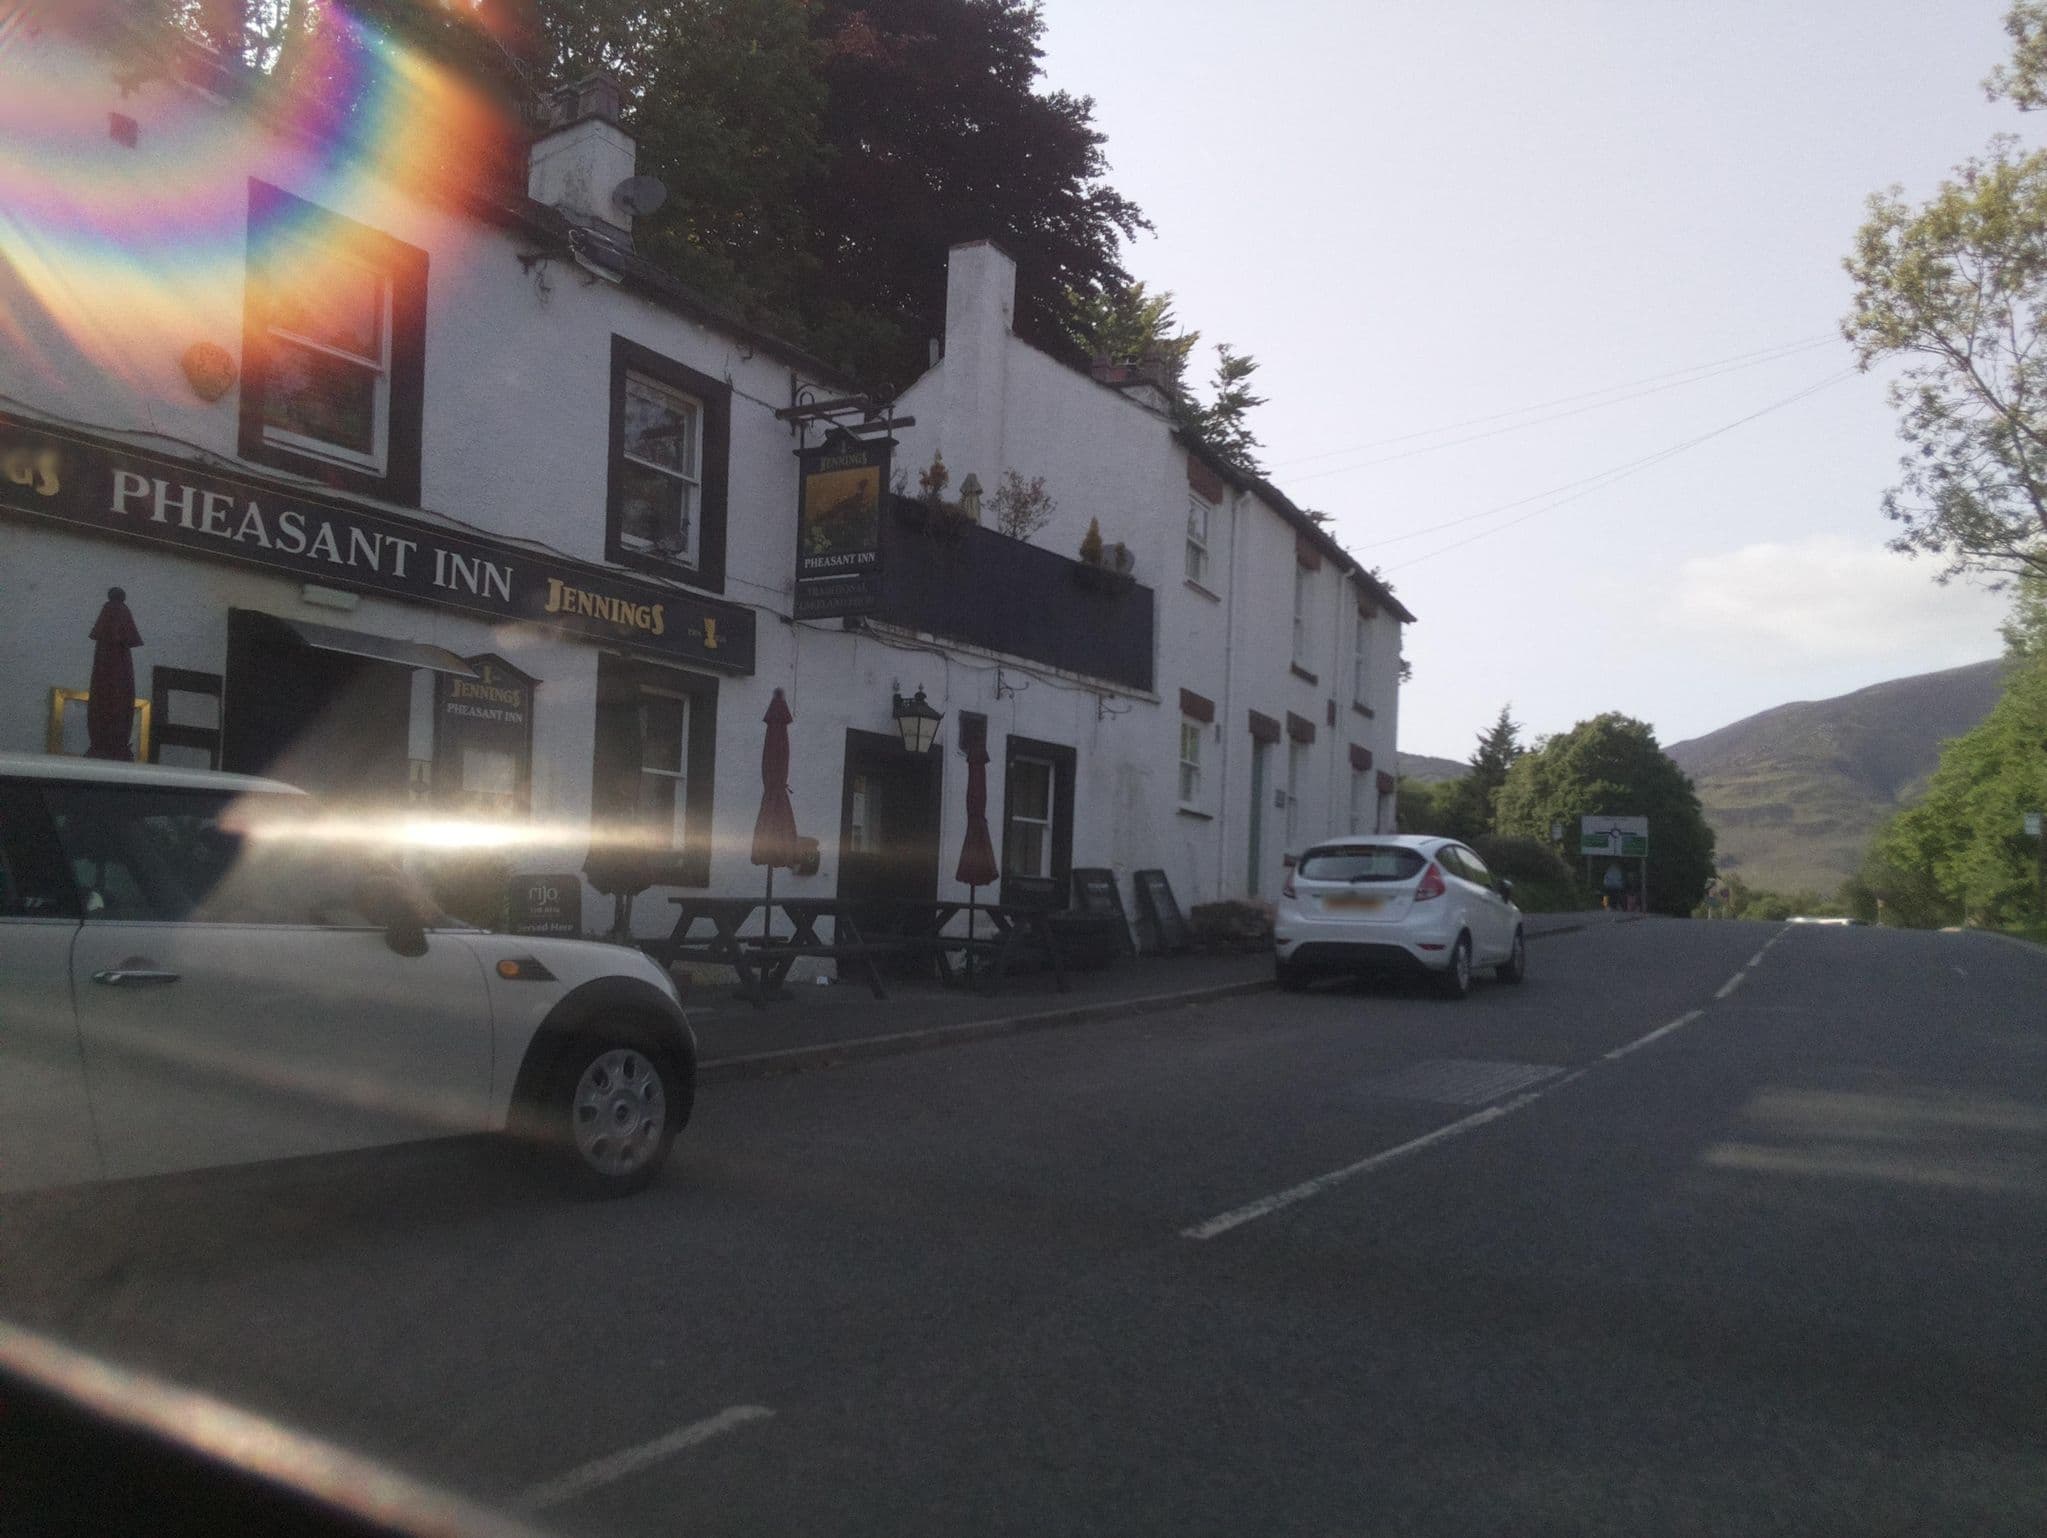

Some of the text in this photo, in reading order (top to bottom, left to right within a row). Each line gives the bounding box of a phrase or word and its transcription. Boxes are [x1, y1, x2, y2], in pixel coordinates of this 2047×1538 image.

[110, 470, 513, 603] PHEASANT INN
[804, 551, 876, 569] PHEASANT INN
[544, 577, 665, 636] JENNINGS
[450, 679, 521, 708] JENNINGS
[446, 702, 523, 724] PHEASANT INN
